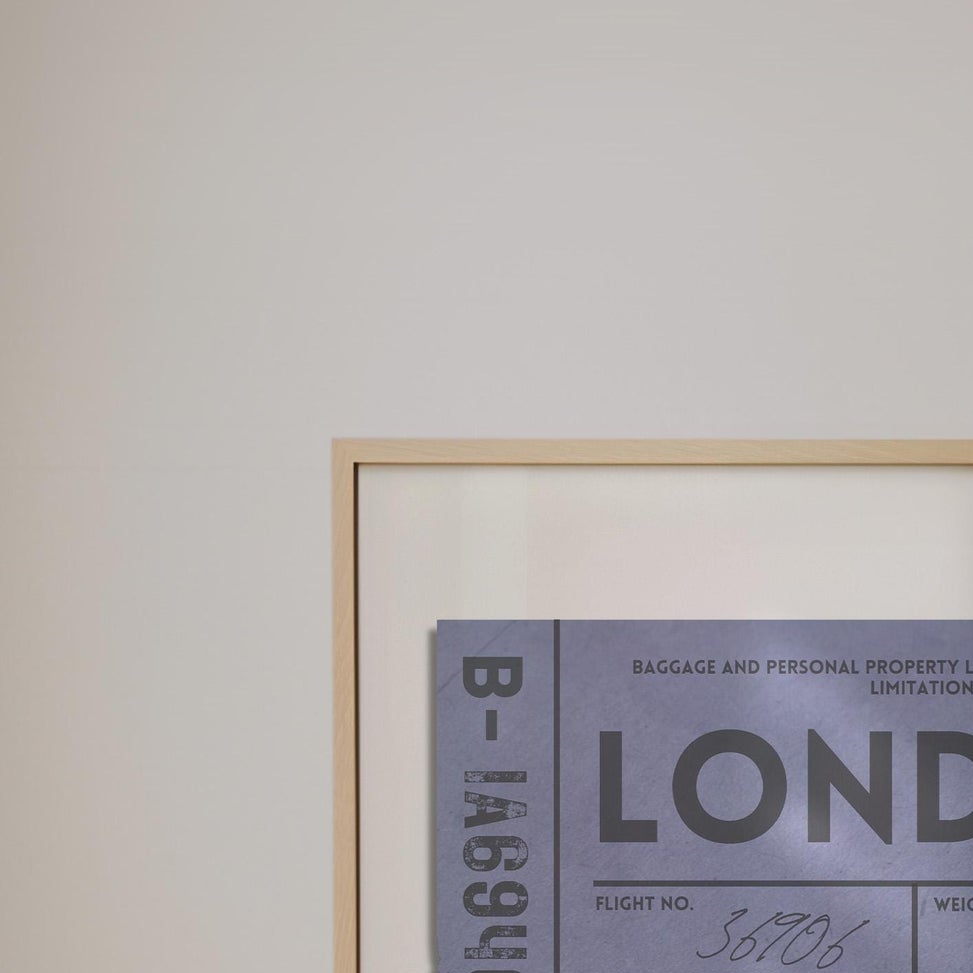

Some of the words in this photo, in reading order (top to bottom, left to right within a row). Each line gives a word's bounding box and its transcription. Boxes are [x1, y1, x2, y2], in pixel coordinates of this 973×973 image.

[632, 659, 716, 675] BAGGAGE
[721, 659, 760, 675] AND
[766, 659, 860, 675] PERSONAL
[865, 659, 960, 675] PROPERTY
[595, 896, 656, 911] FLIGHT
[661, 896, 694, 911] NO.
